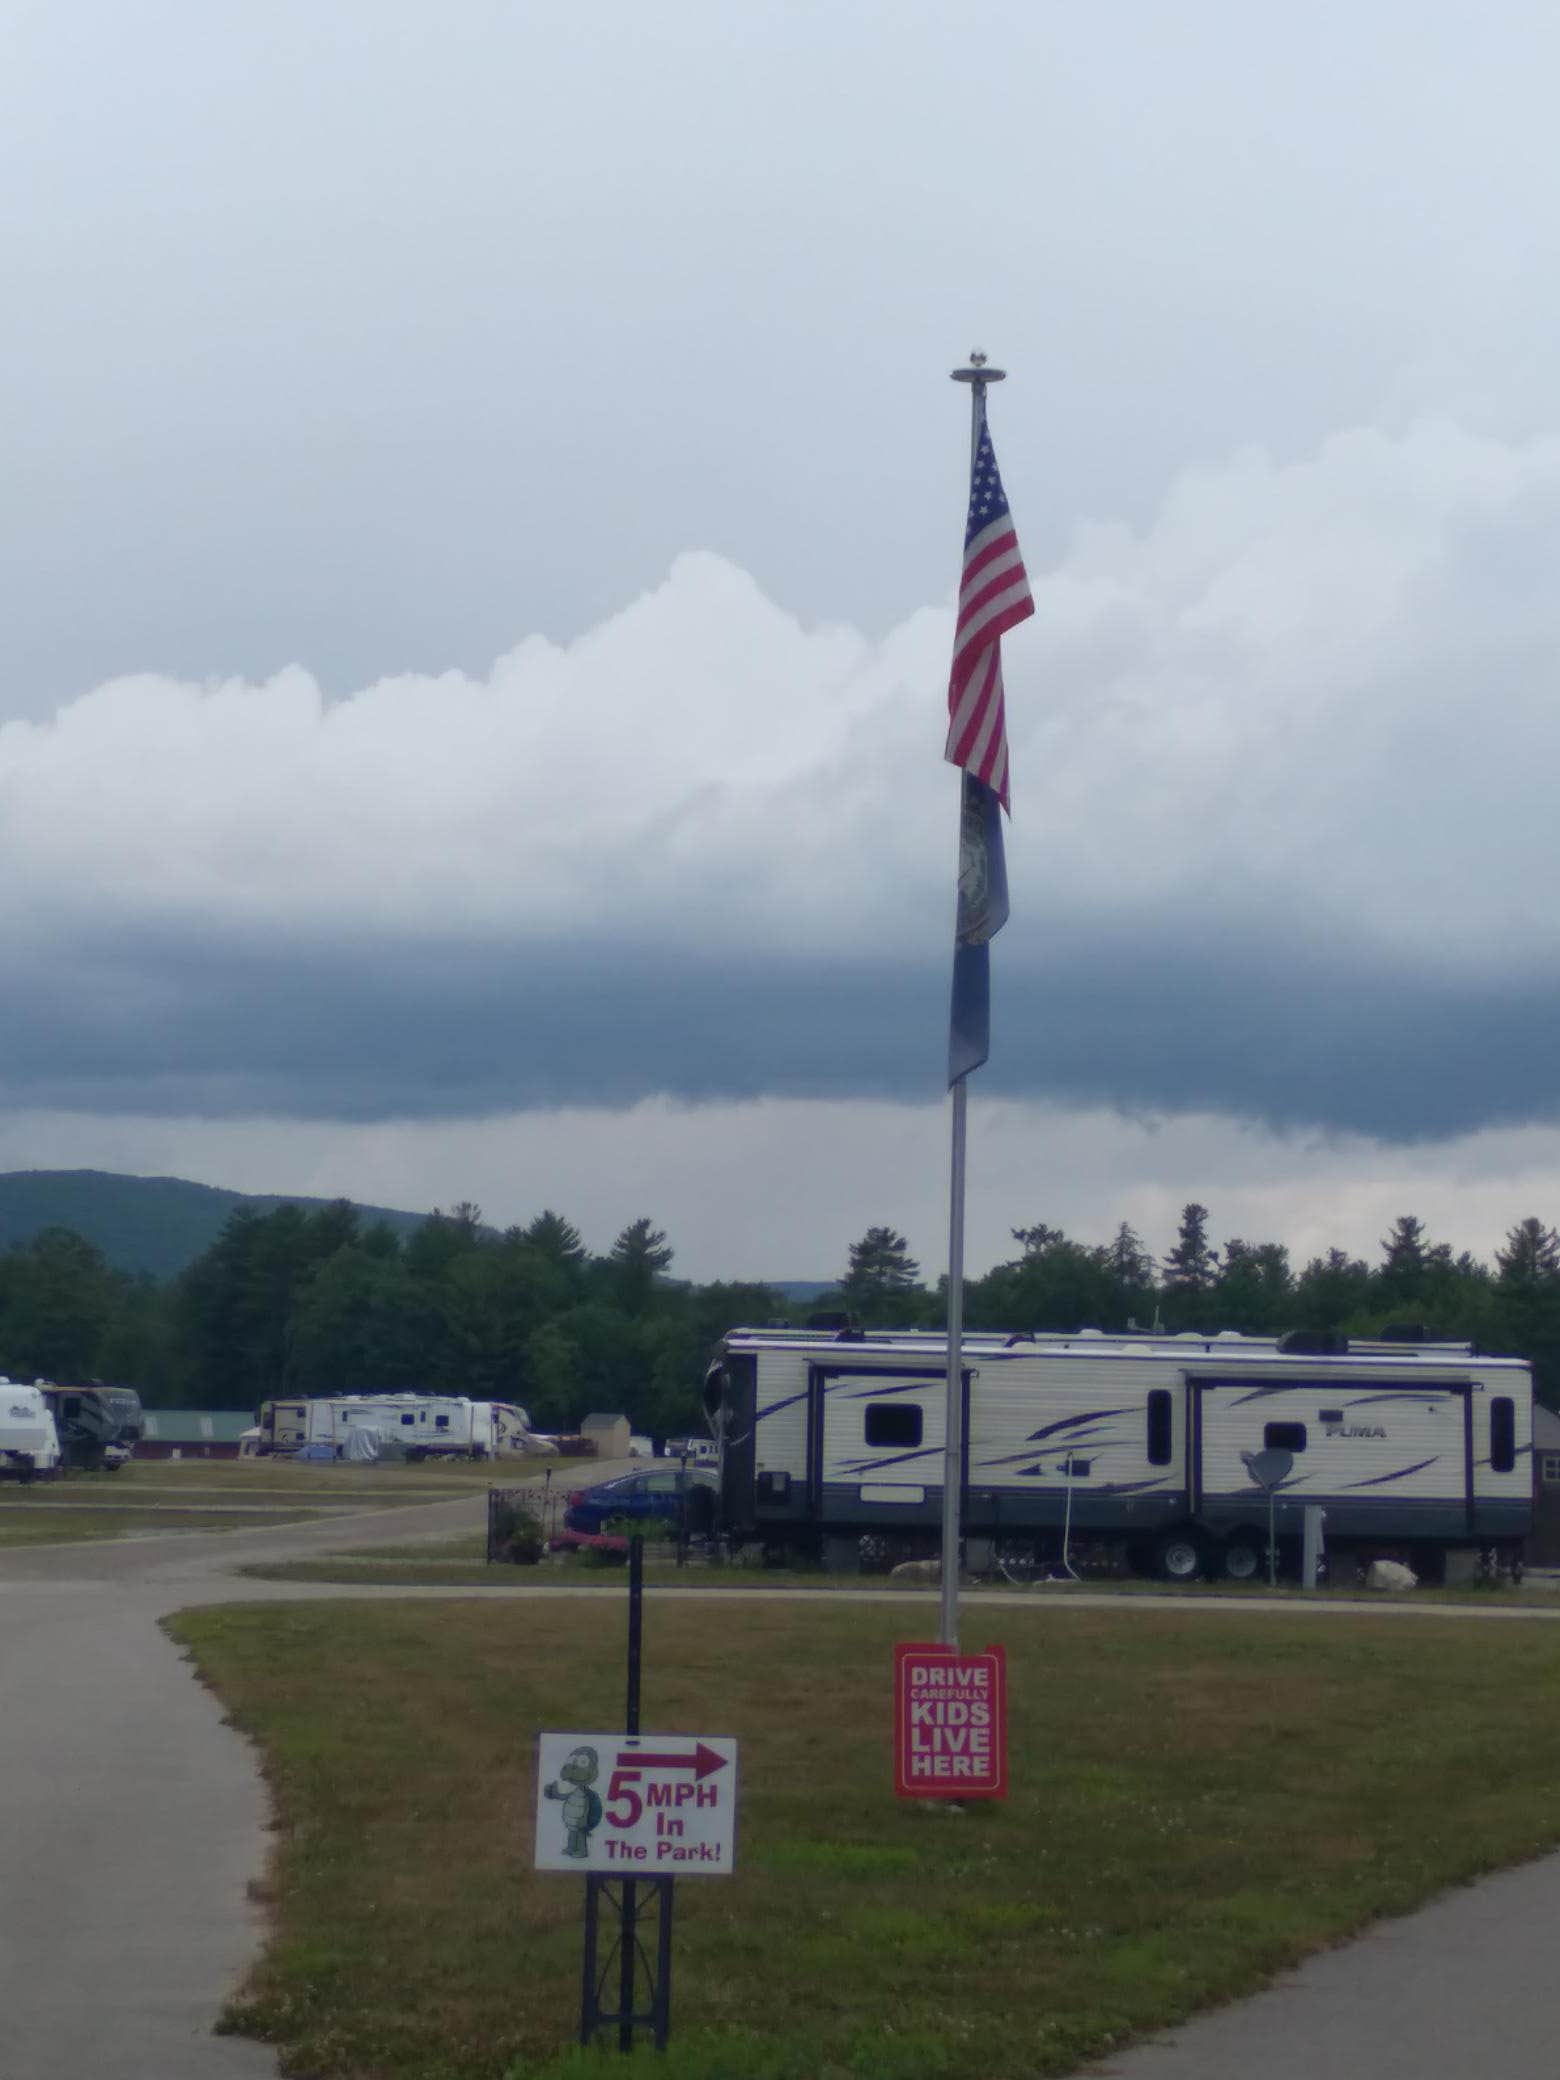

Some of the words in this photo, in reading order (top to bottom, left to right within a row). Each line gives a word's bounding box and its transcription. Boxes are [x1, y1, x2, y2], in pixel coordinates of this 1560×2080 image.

[911, 1667, 989, 1686] DRIVE
[910, 1688, 988, 1700] CAREFULLY
[911, 1701, 990, 1725] KIDS
[911, 1727, 990, 1752] LIVE
[911, 1755, 990, 1776] HERE
[605, 1771, 643, 1829] 5
[646, 1782, 718, 1807] MPH
[656, 1811, 684, 1836] In
[605, 1840, 648, 1860] The
[656, 1841, 721, 1862] Park!
